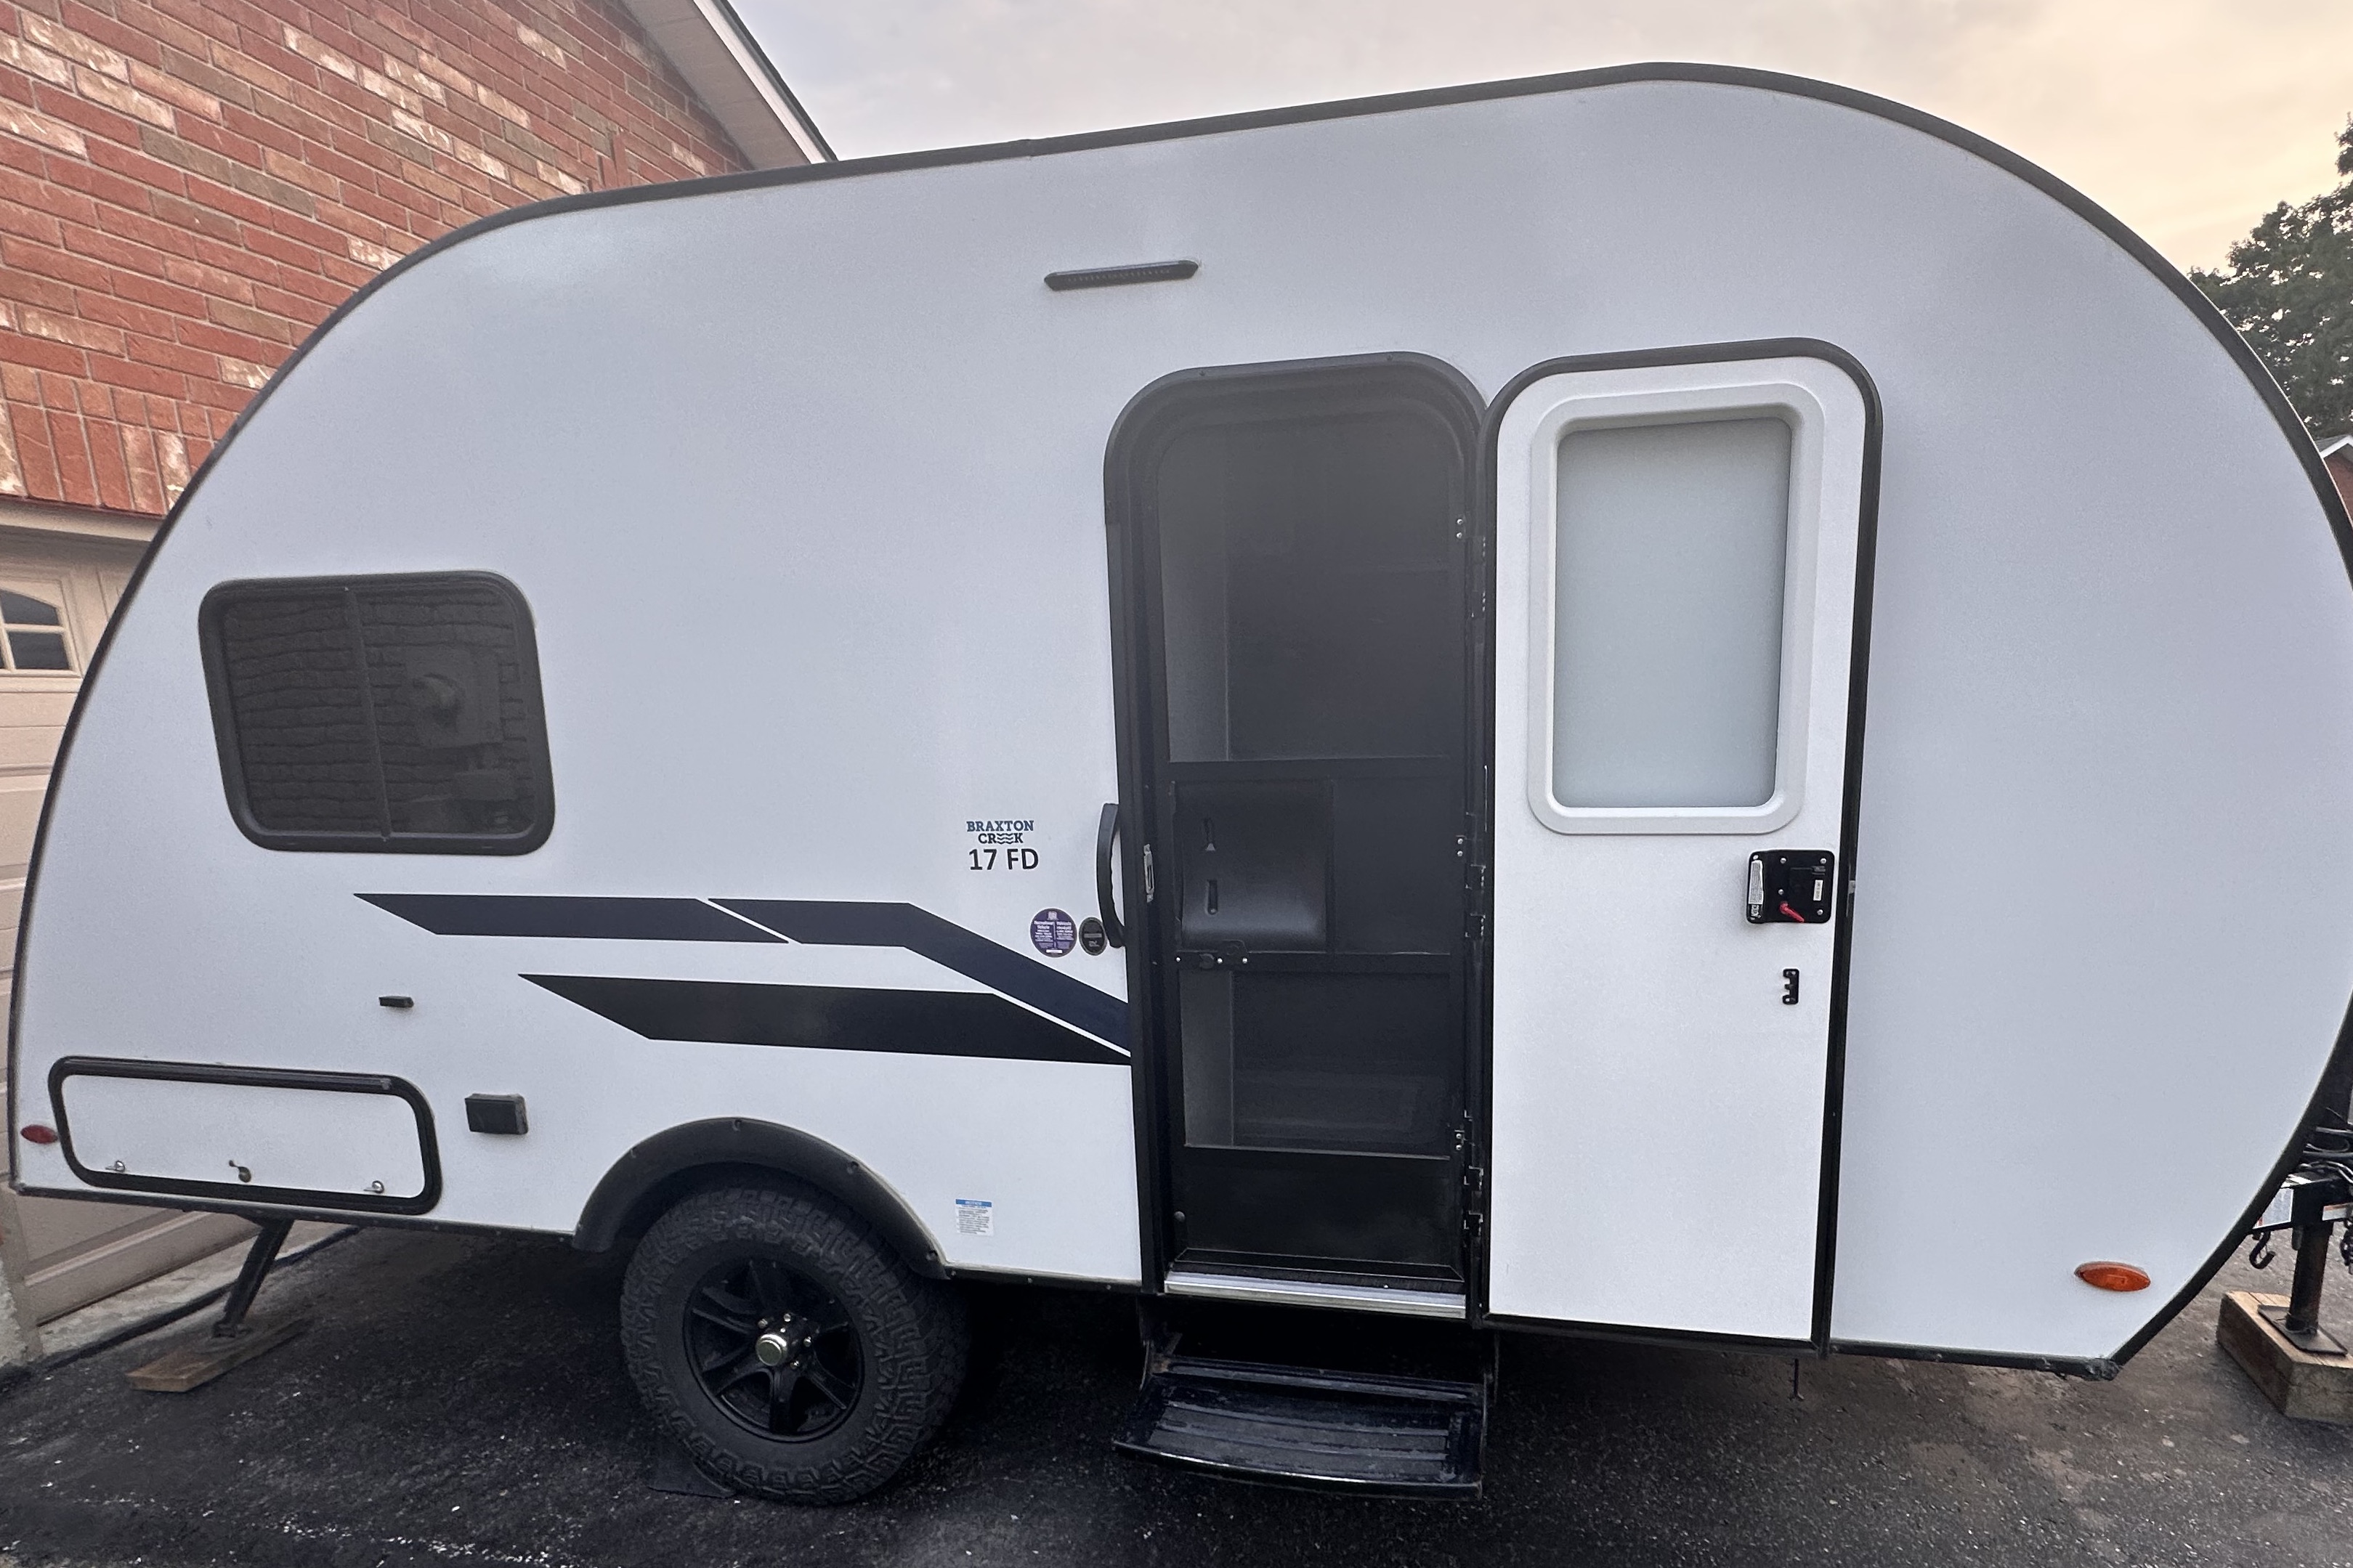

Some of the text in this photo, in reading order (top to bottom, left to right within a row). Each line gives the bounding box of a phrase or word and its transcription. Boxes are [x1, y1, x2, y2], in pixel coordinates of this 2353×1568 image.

[966, 820, 1034, 832] BRAXTON
[968, 848, 1039, 871] 17 FD
